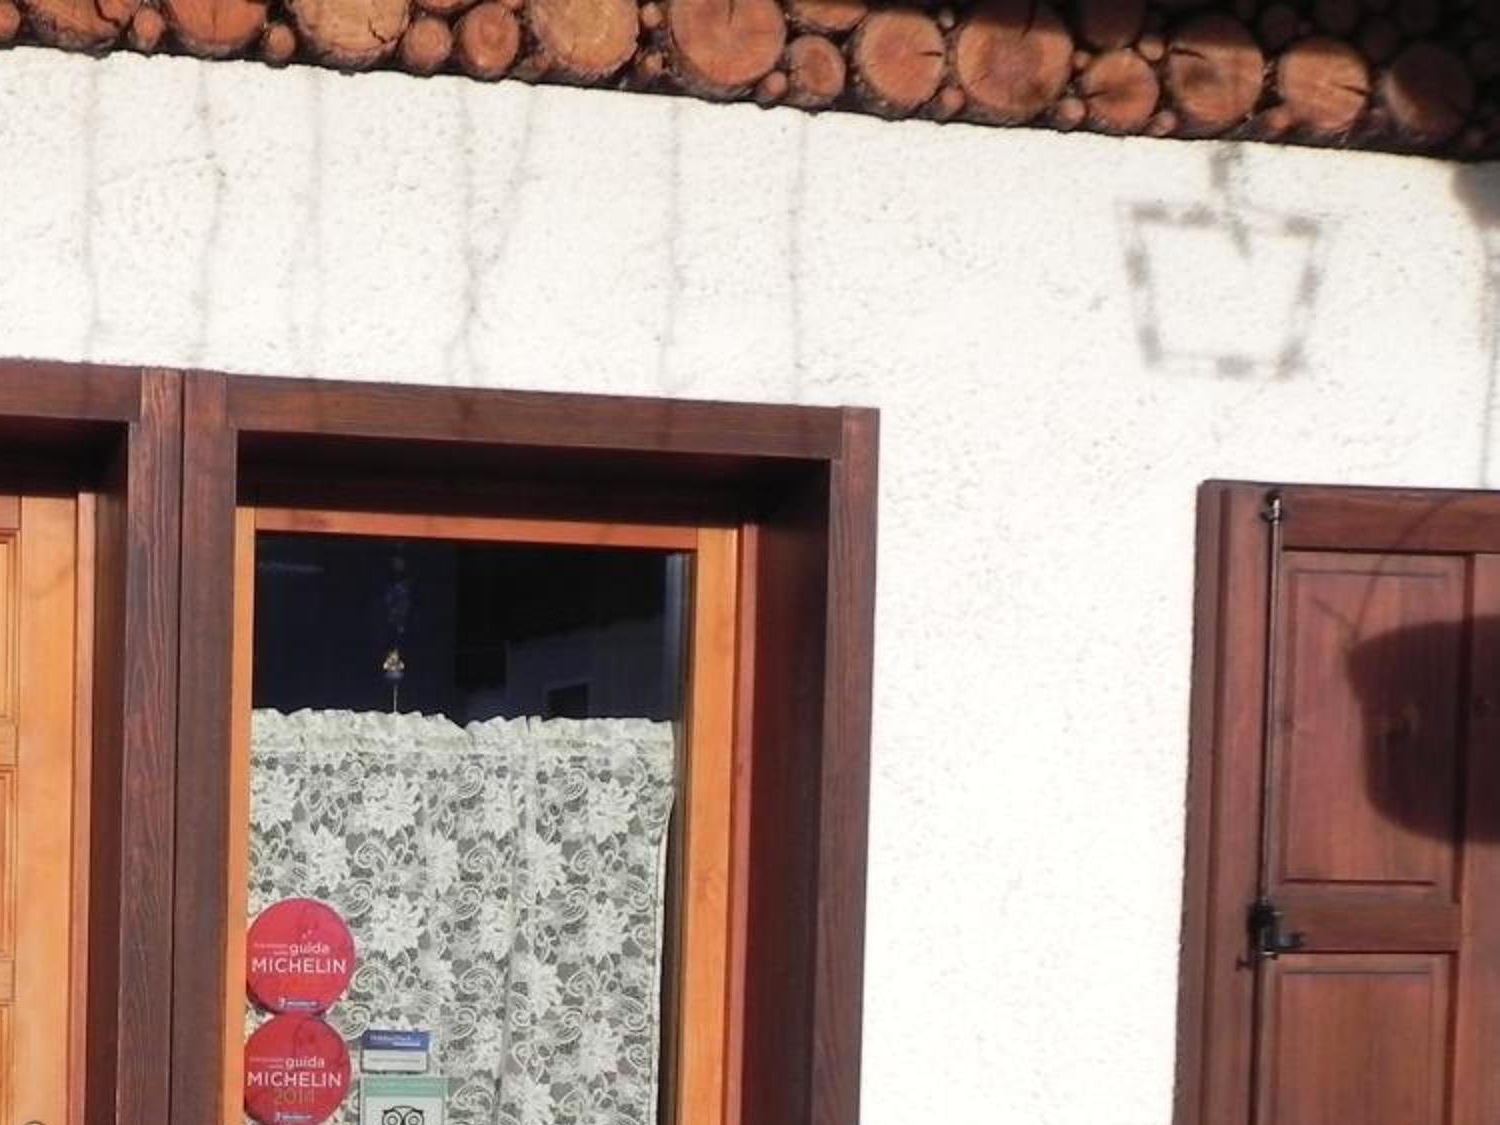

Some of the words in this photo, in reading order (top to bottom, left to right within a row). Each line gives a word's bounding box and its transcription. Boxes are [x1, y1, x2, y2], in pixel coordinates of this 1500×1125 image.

[288, 942, 331, 957] guida
[251, 957, 347, 974] MICHELIN
[284, 1056, 325, 1071] guida
[247, 1071, 342, 1087] MICHELIN
